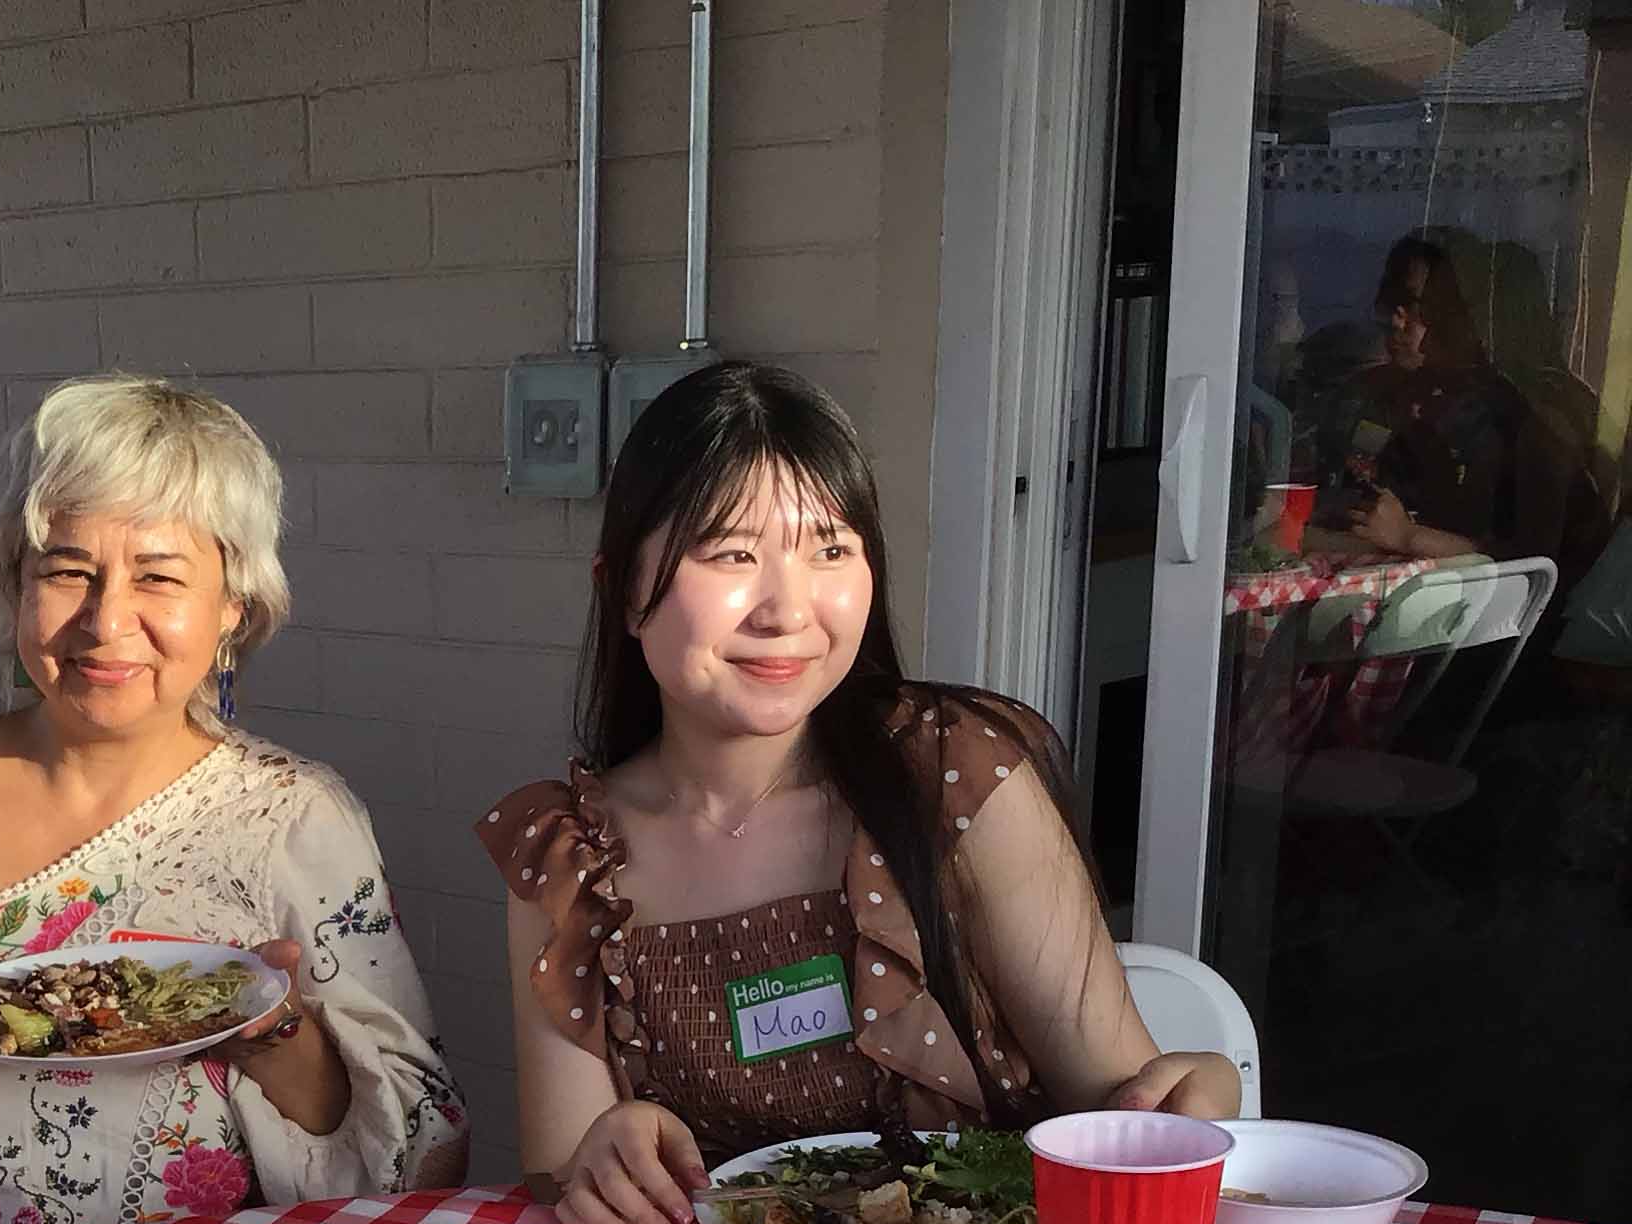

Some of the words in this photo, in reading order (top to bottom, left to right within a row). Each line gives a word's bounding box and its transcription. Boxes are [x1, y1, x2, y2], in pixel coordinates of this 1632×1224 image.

[732, 978, 784, 1007] Hello
[785, 984, 798, 993] my
[799, 976, 824, 987] name
[753, 1005, 826, 1050] Mao
